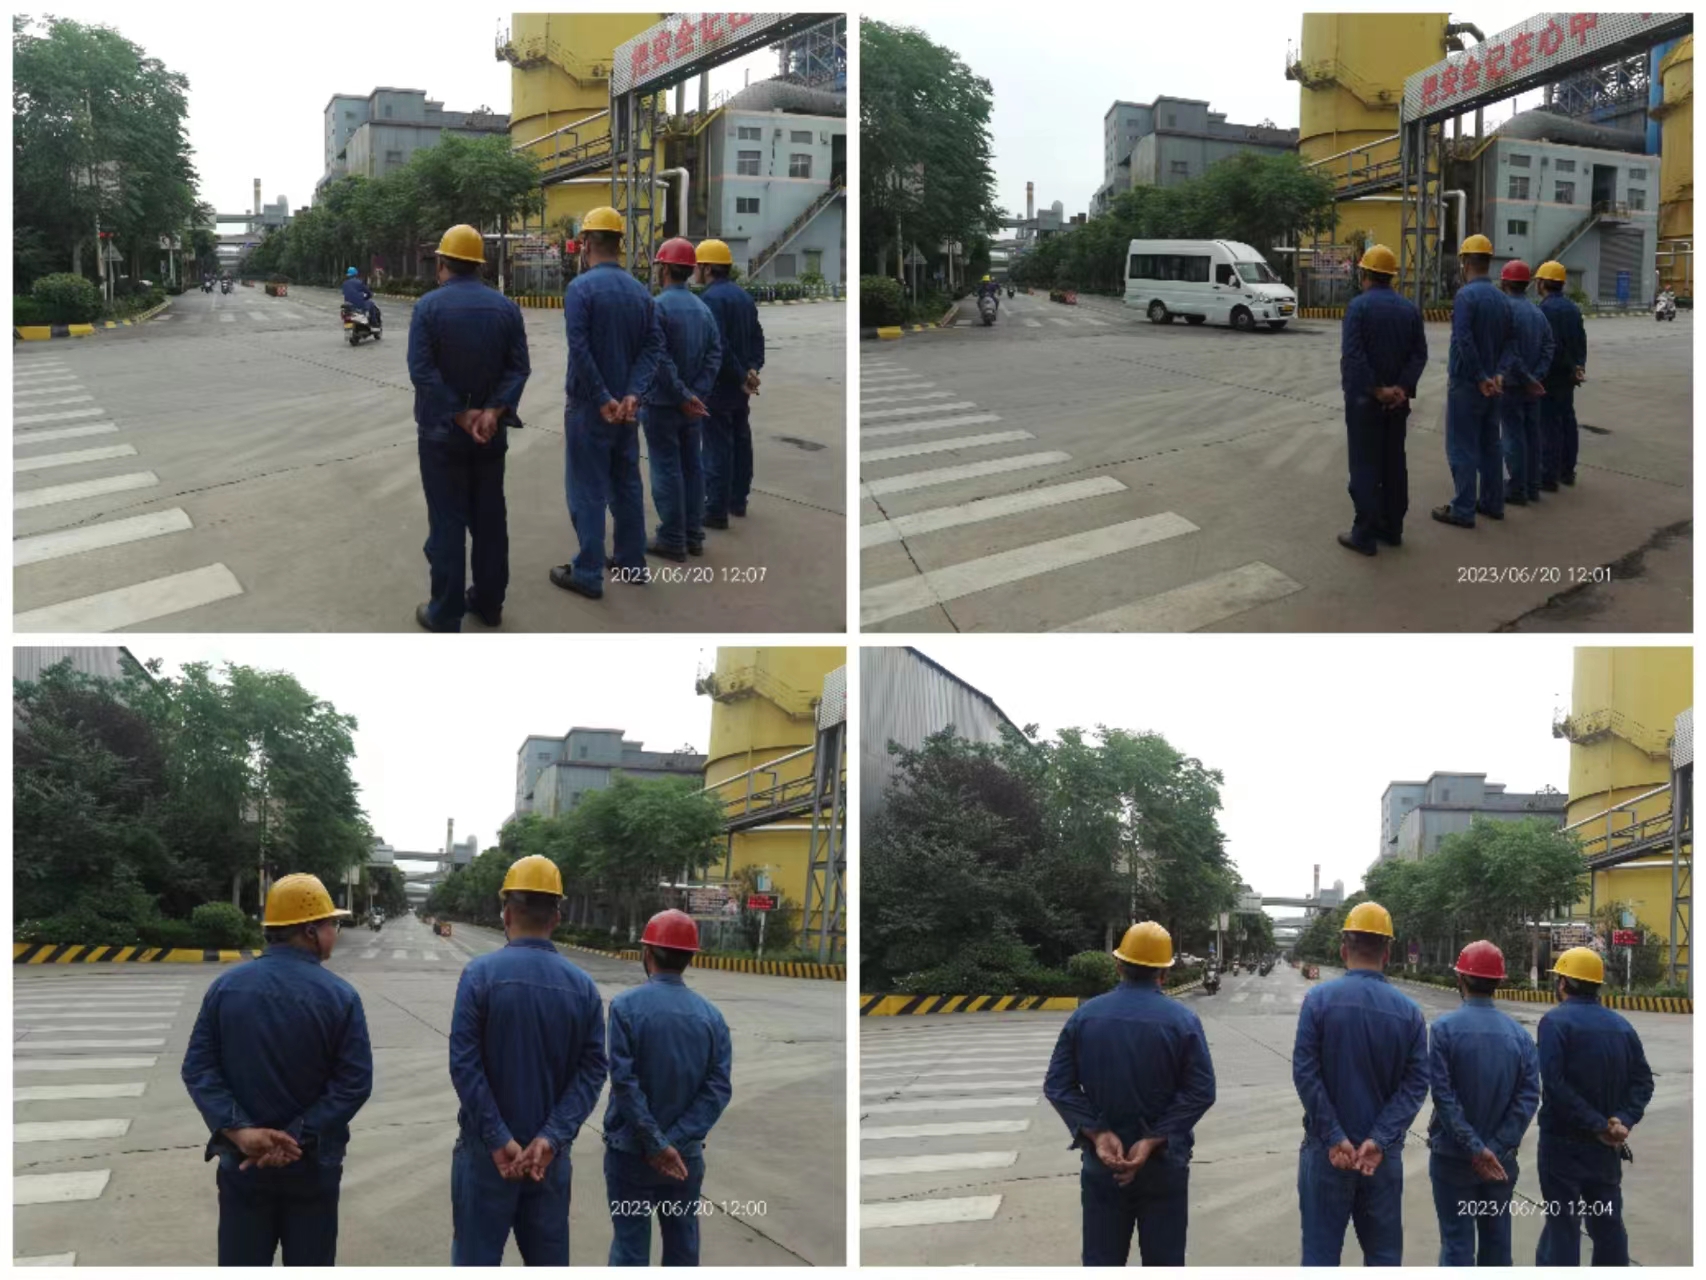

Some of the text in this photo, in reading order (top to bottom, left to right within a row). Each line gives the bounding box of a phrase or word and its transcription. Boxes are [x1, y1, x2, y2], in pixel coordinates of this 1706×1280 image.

[1420, 12, 1598, 112] 把安全记在心中
